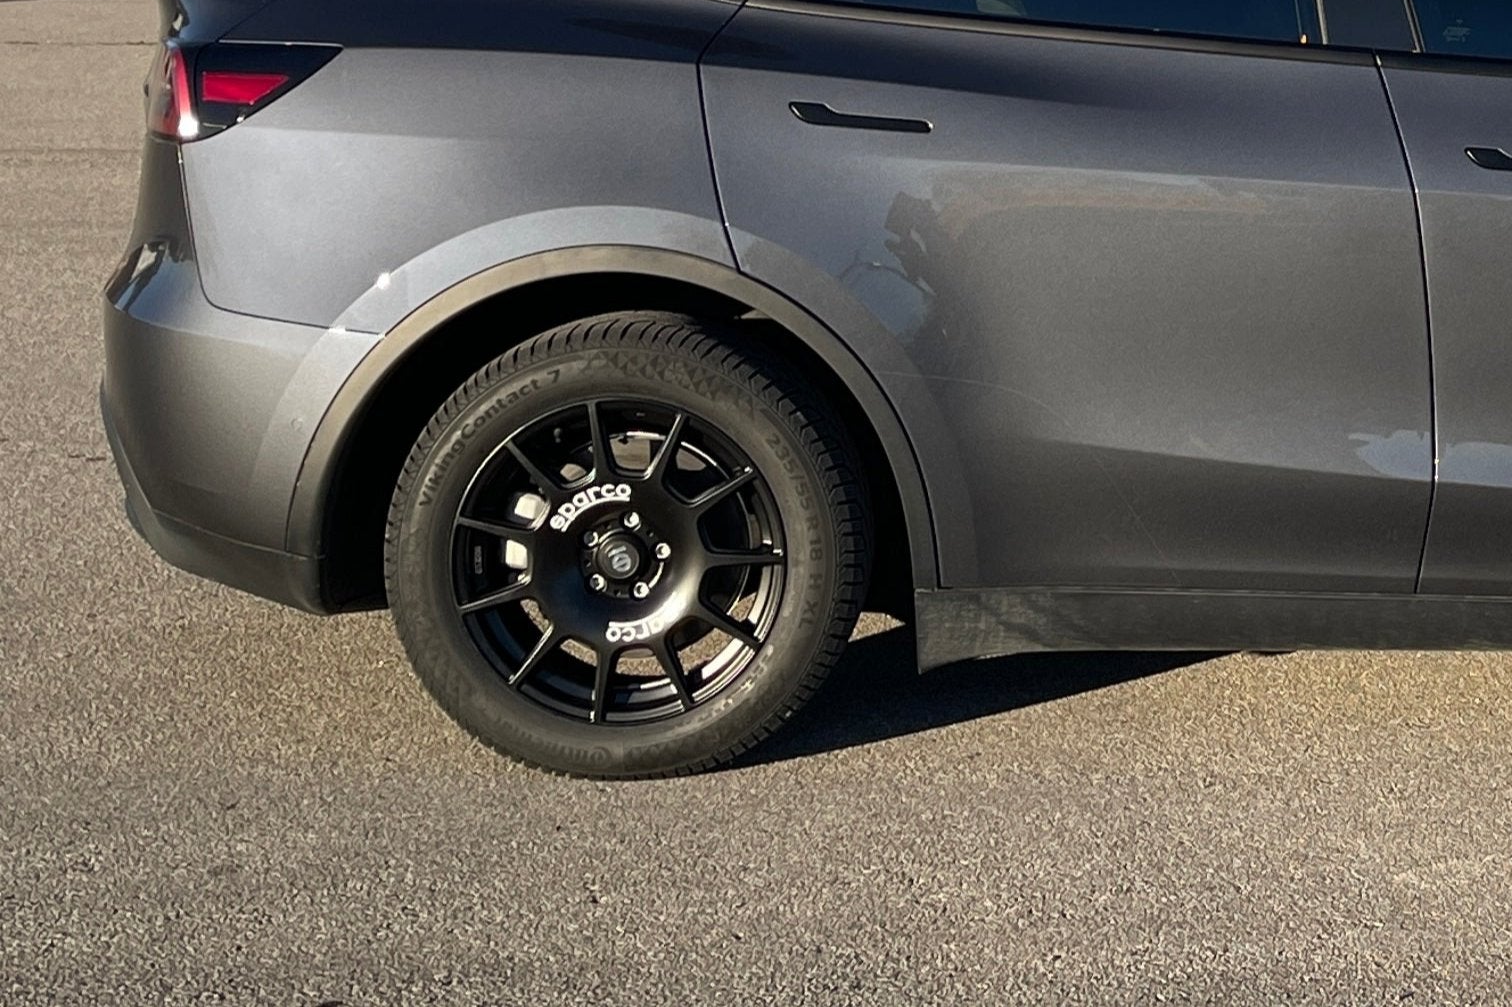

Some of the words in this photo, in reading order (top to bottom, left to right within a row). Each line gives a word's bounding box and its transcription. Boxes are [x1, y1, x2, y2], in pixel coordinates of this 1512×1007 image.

[419, 378, 540, 507] VikingContact
[547, 369, 561, 384] 7
[550, 483, 632, 531] sparco
